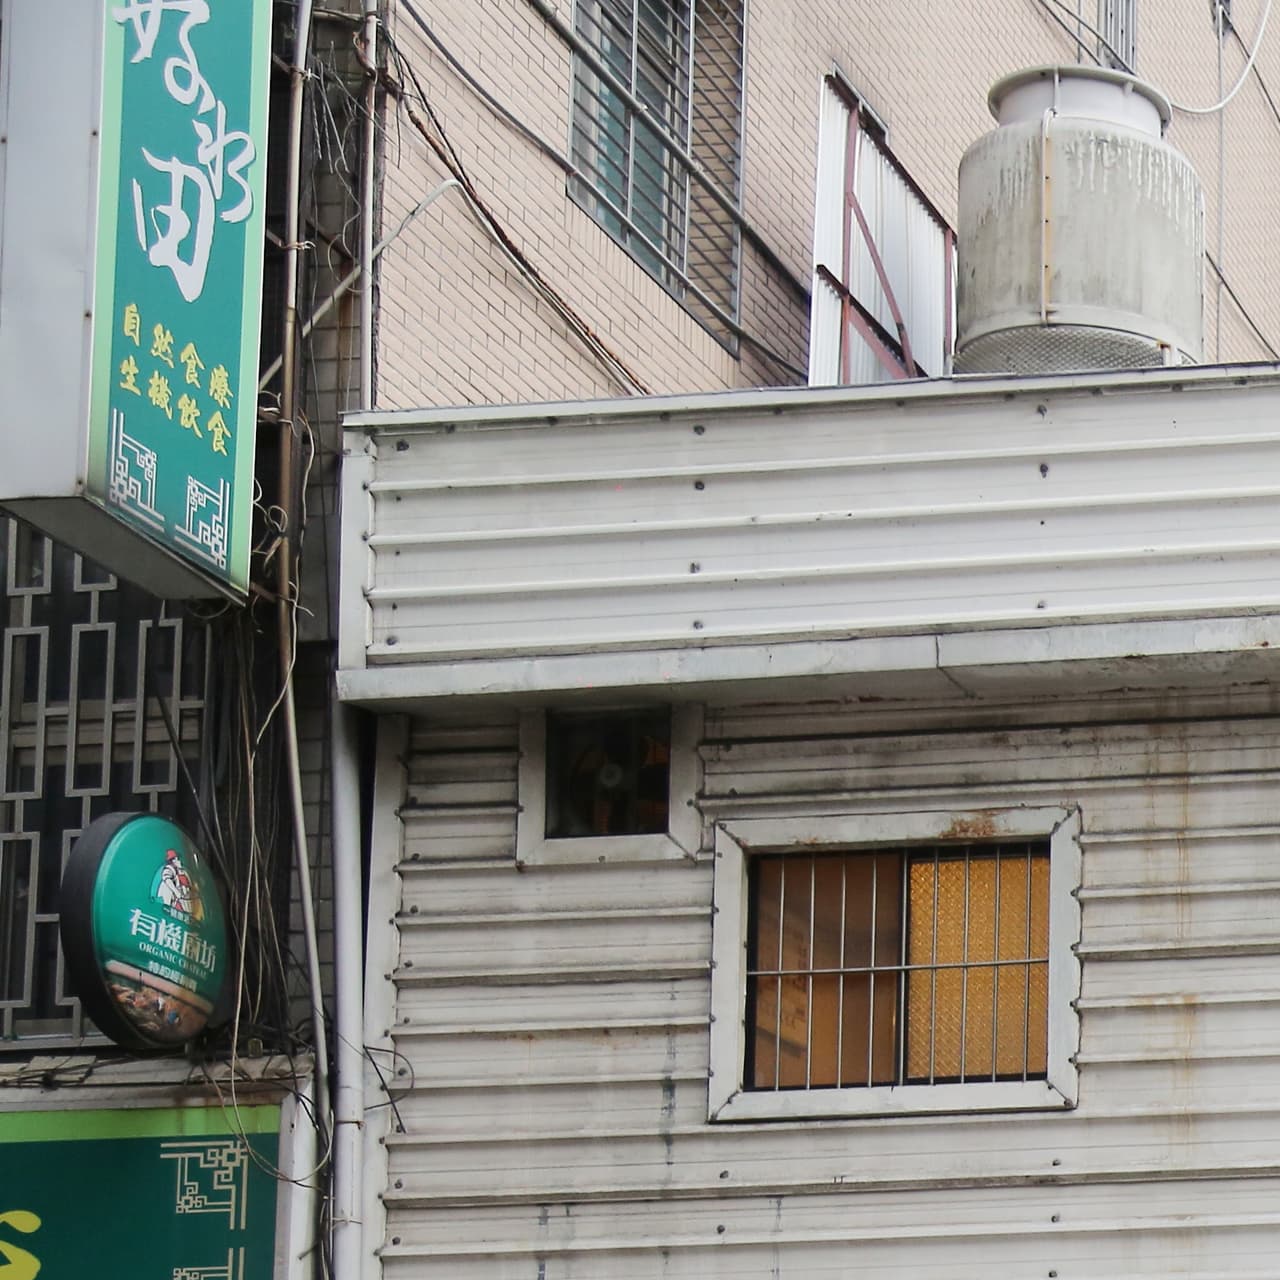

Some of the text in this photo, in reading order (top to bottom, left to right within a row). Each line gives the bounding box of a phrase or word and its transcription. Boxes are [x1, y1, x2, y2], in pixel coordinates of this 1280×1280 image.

[119, 355, 232, 457] 生機飲食
[123, 303, 234, 410] 自然食療
[138, 941, 177, 963] ORGANIC
